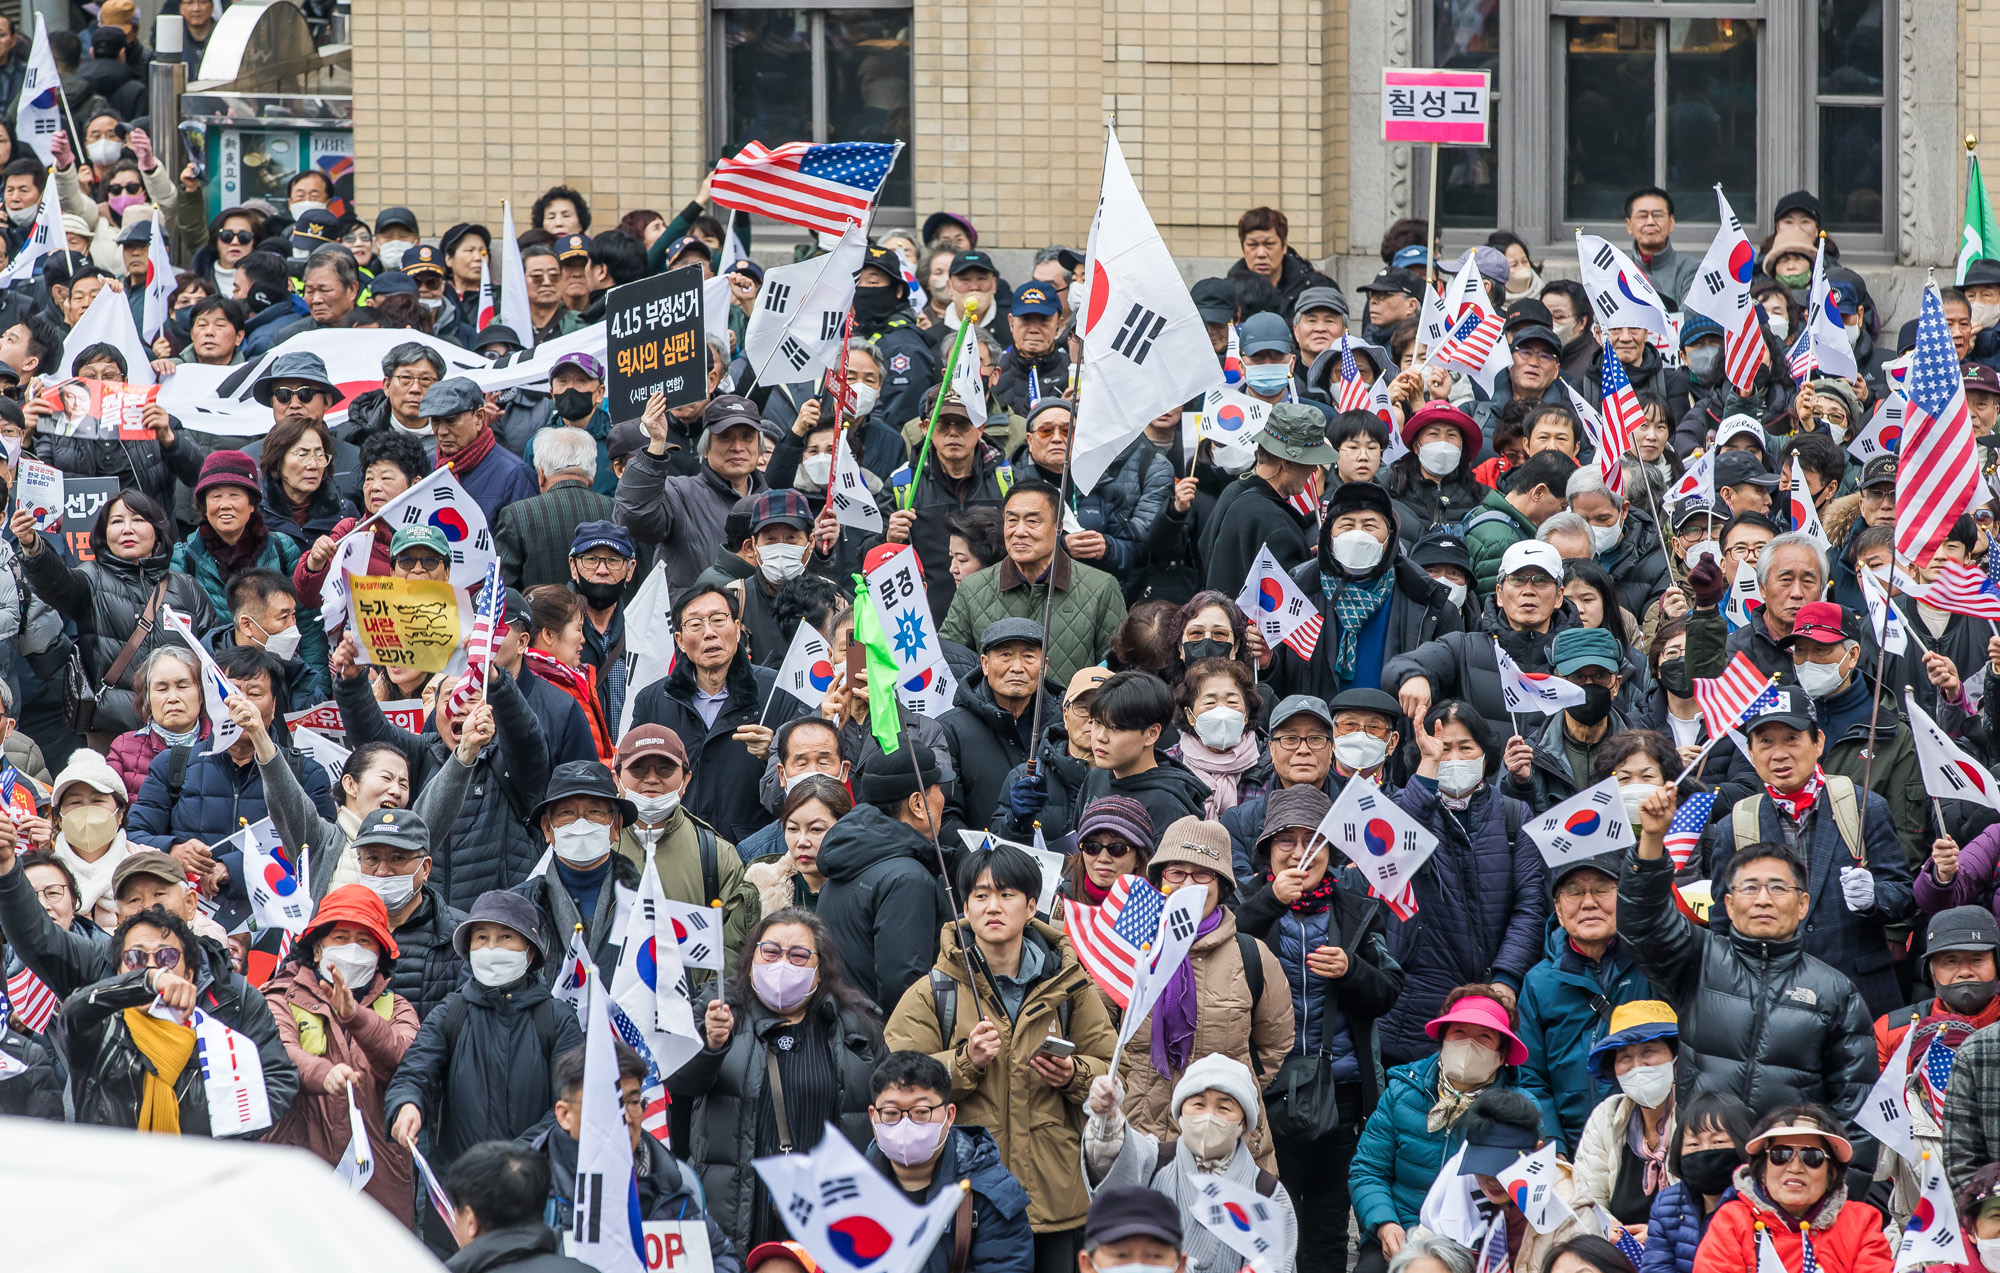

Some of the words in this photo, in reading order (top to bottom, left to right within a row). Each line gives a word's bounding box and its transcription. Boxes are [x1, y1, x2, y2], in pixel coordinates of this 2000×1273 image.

[1388, 90, 1480, 118] 칠성고
[314, 138, 346, 153] DBR
[610, 308, 642, 341] 4.15
[645, 288, 700, 330] 부정선거
[617, 341, 659, 377] 역사의
[662, 330, 696, 367] 심판!
[649, 382, 664, 395] 미래
[1724, 418, 1761, 435] Titleist
[406, 526, 433, 535] CALIFORNIA
[66, 532, 97, 561] 판
[879, 566, 914, 611] 문경
[359, 600, 389, 616] 누가
[363, 617, 396, 633] 내란
[370, 634, 403, 648] 세력
[902, 620, 917, 648] 3
[376, 649, 416, 665] 인가?
[1971, 931, 1981, 941] N
